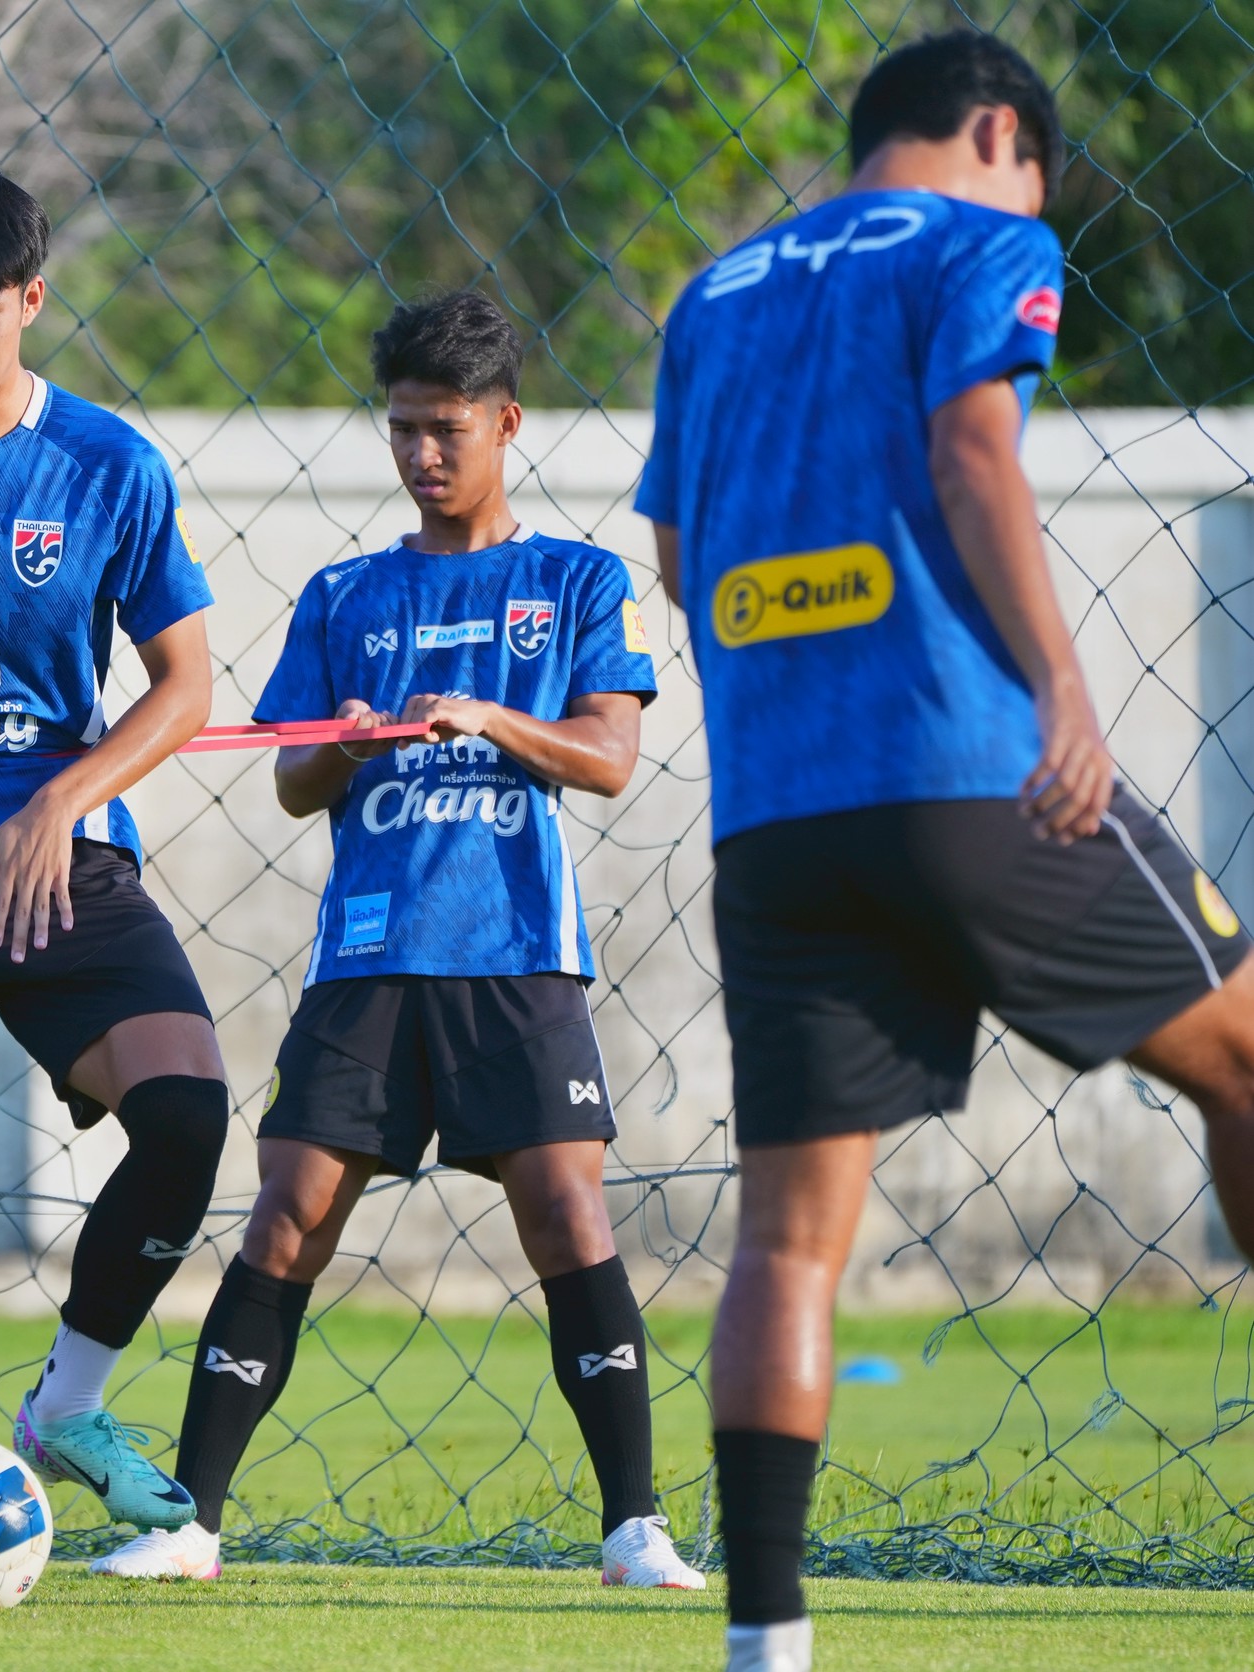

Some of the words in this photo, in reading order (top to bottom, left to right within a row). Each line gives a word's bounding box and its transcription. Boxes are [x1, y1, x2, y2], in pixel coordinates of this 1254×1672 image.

[703, 206, 926, 300] BYD
[16, 522, 63, 533] THAILAND
[511, 602, 553, 612] THAILAND
[721, 572, 873, 638] B-Quik
[436, 625, 491, 643] DAIKIN
[439, 769, 517, 785] เครื่องดื่มตราช้าง
[362, 777, 528, 837] Chang
